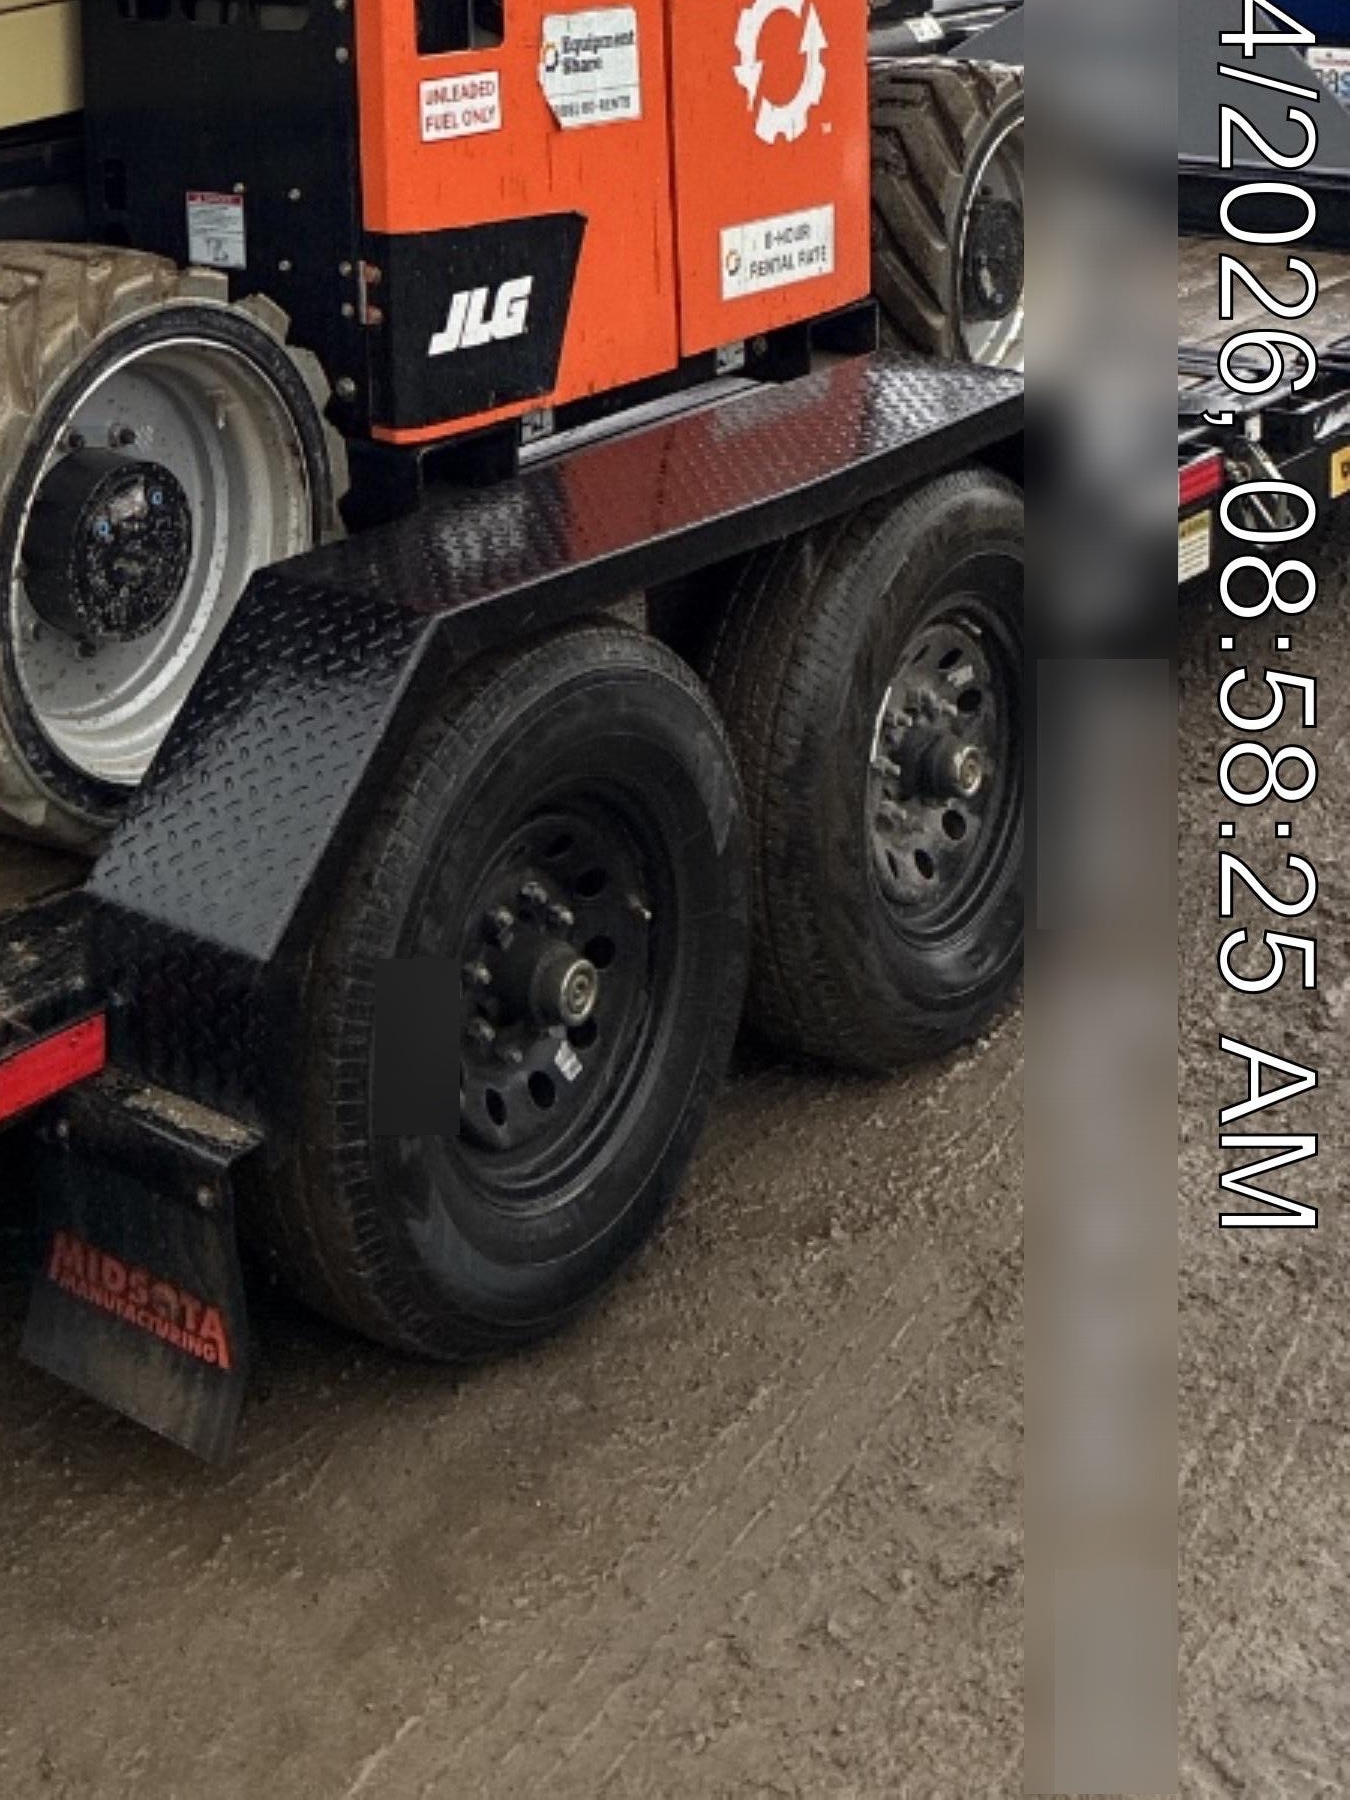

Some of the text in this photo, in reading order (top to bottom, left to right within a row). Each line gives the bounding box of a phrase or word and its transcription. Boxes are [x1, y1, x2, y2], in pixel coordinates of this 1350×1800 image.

[561, 30, 635, 56] Equipment
[562, 53, 603, 75] Share
[426, 80, 495, 105] UNLEADED
[426, 104, 496, 134] FUEL ONLY
[428, 275, 534, 358] JLG
[58, 1276, 217, 1364] MANUFACTURING
